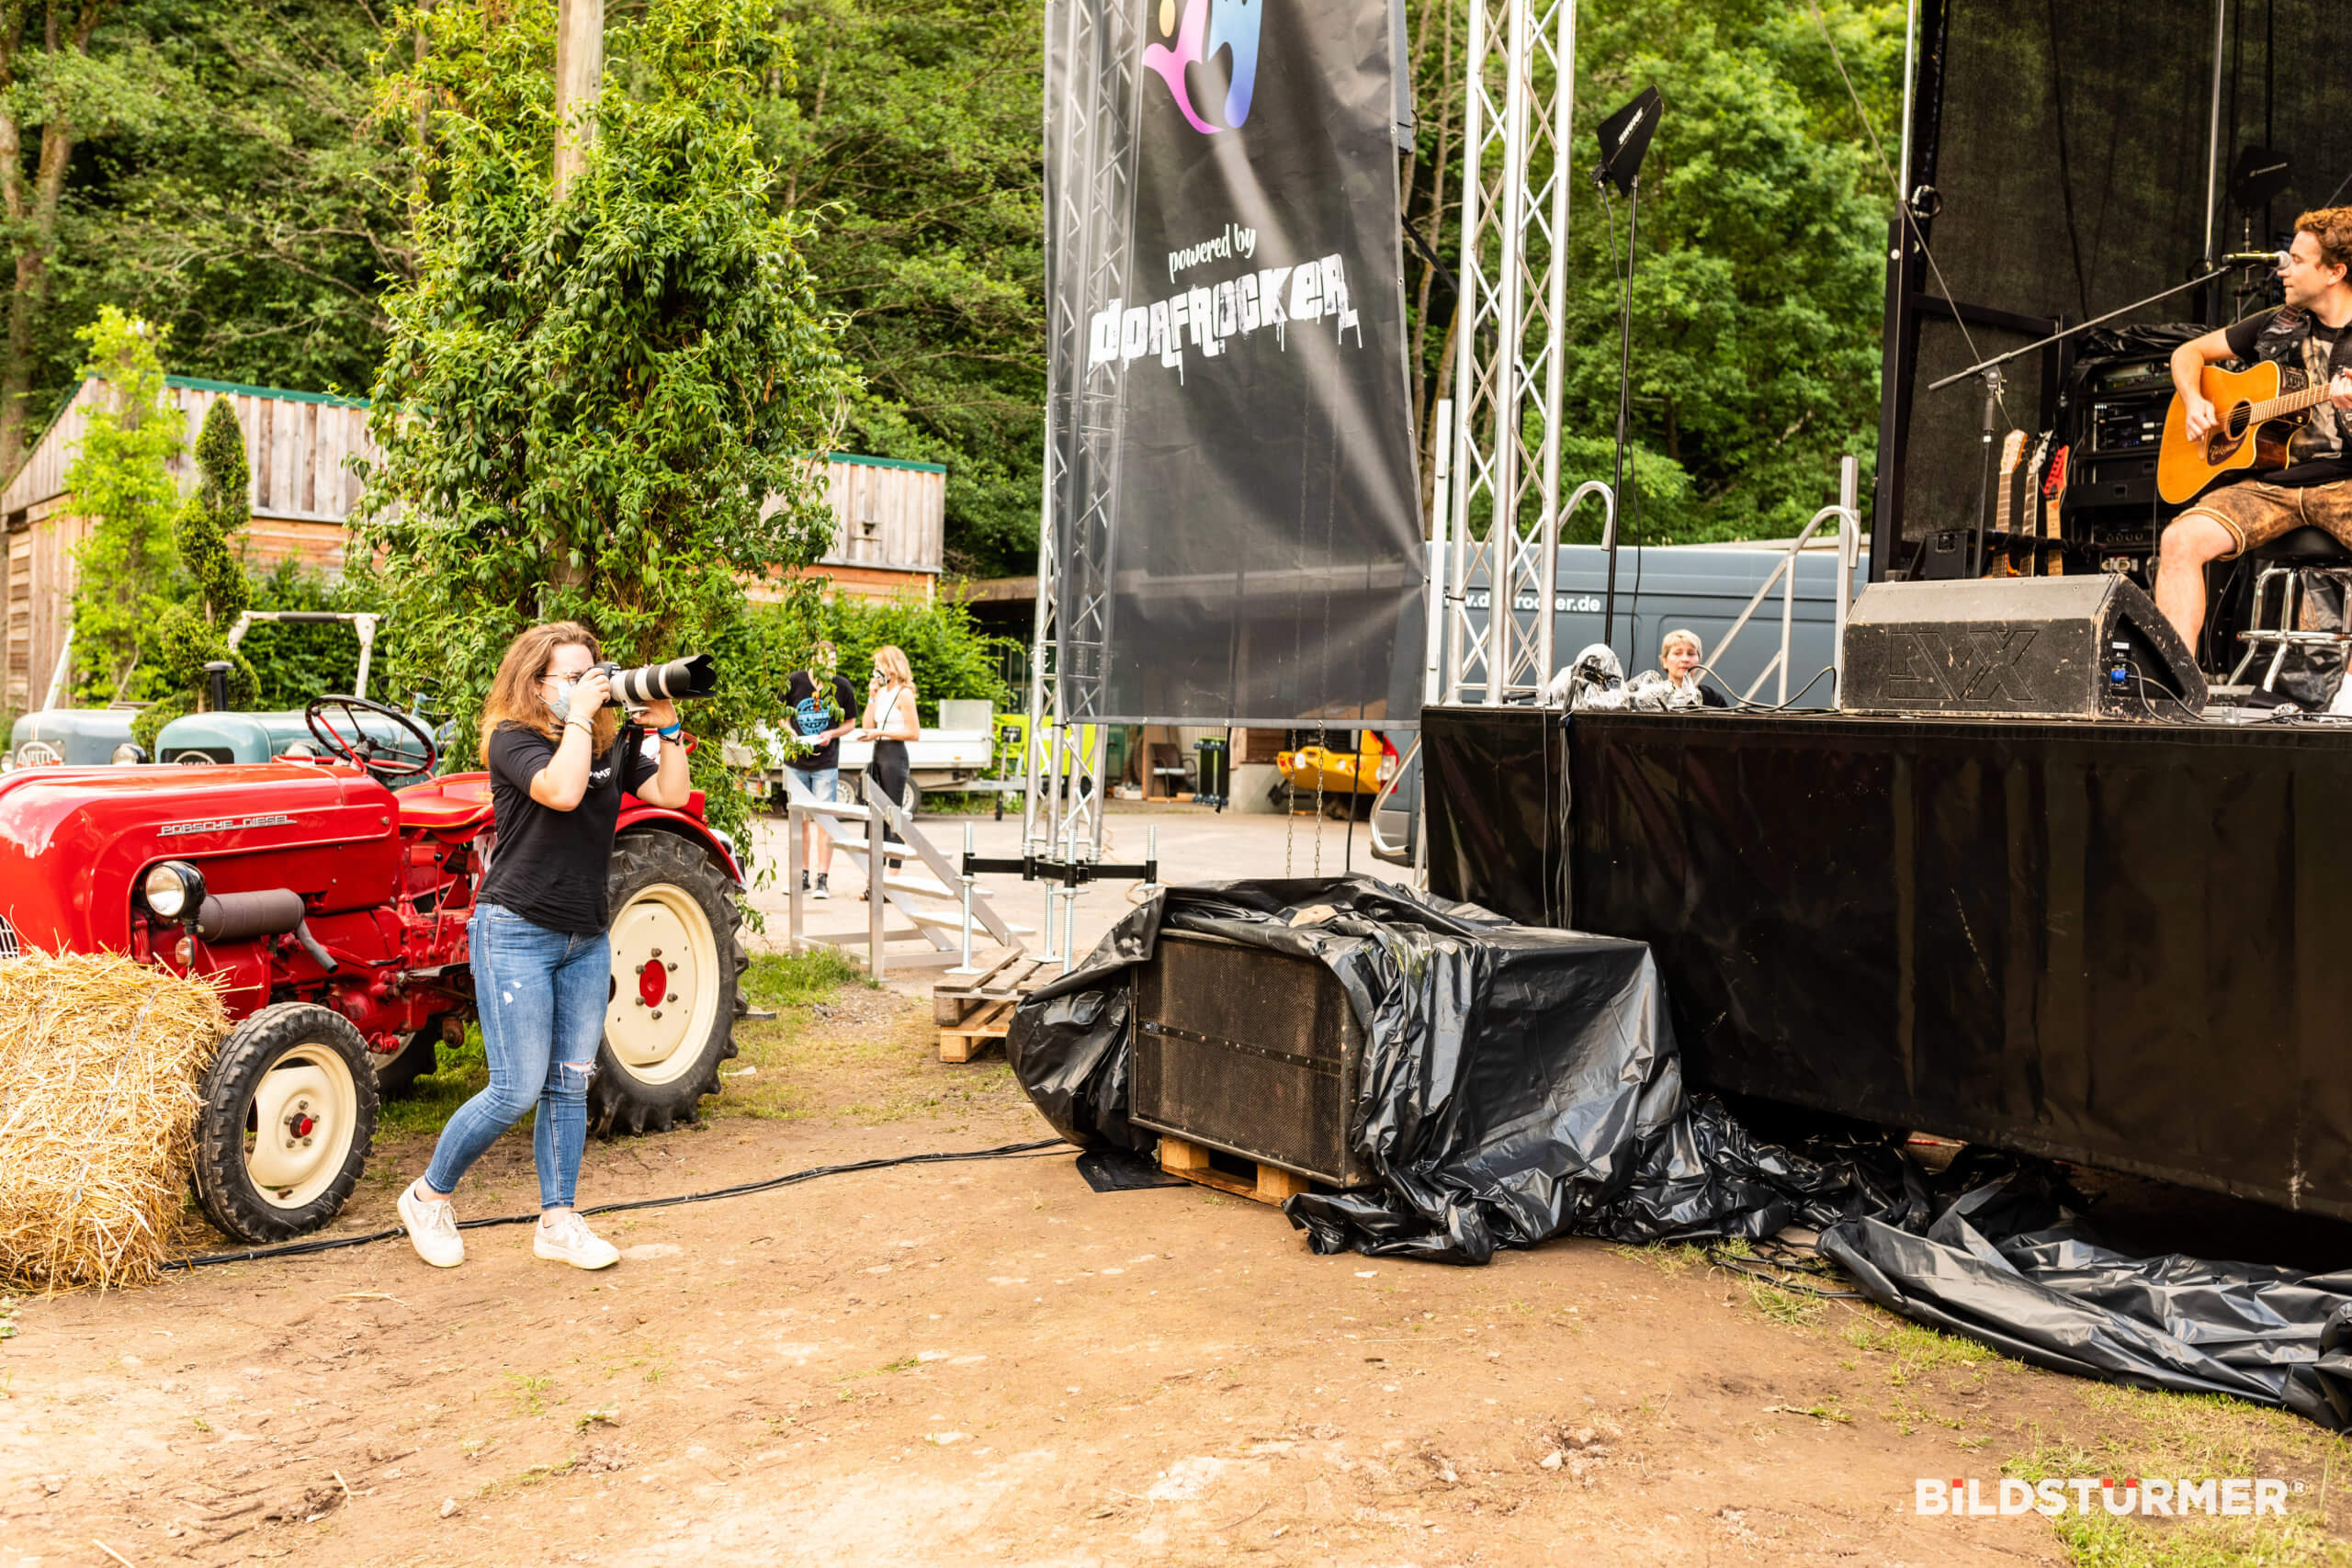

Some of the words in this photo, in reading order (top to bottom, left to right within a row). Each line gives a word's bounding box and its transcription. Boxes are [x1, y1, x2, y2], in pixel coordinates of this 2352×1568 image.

[1169, 223, 1232, 284] powered
[1234, 223, 1256, 259] by
[161, 820, 233, 835] PORSCHE
[243, 815, 288, 828] DIESEL
